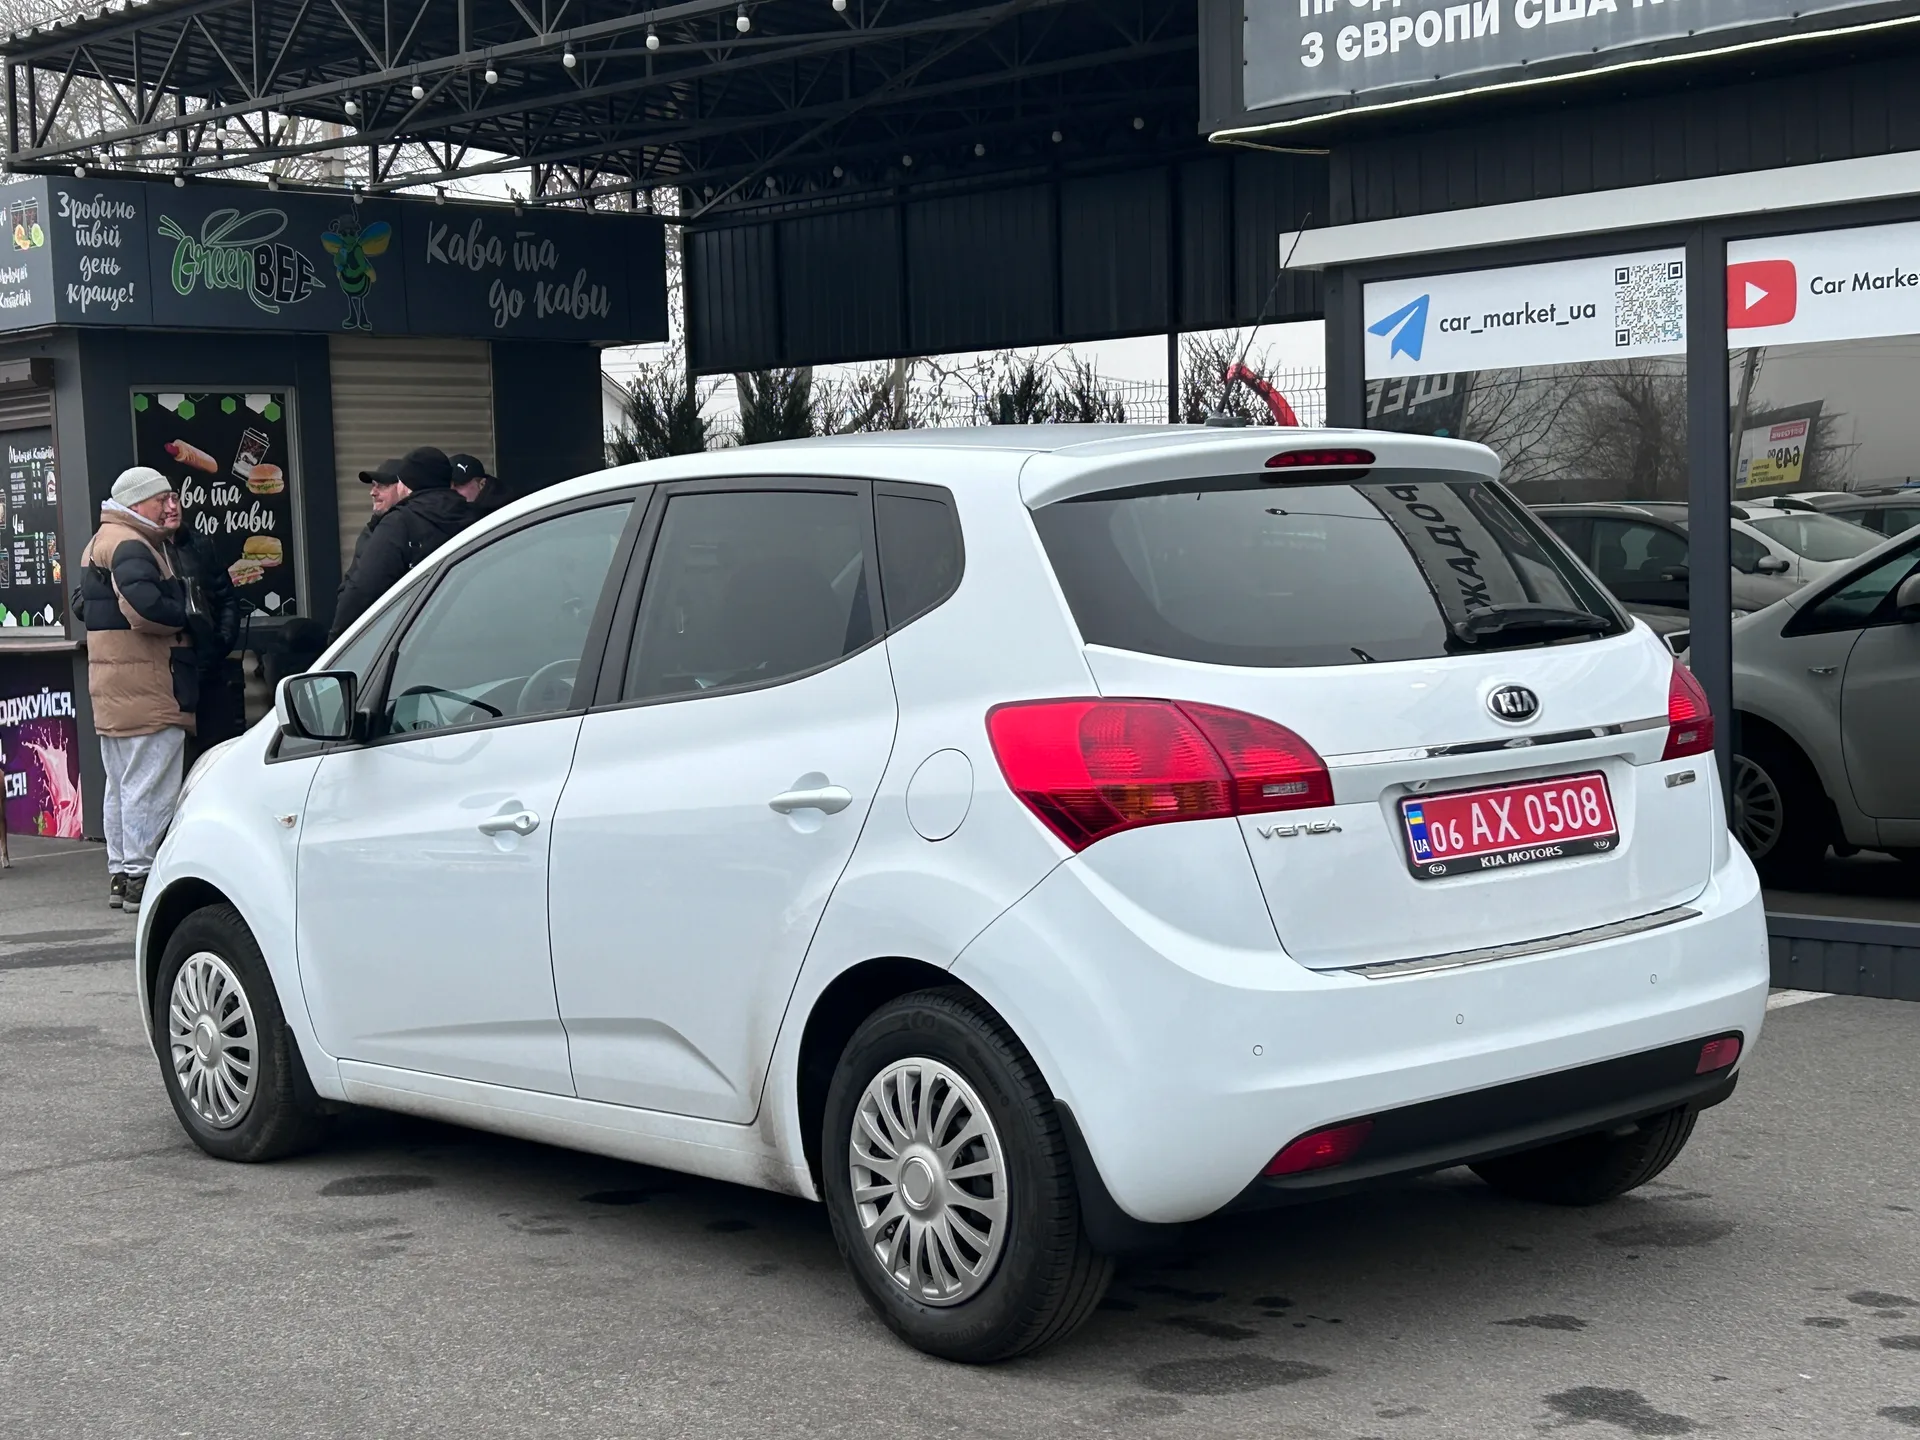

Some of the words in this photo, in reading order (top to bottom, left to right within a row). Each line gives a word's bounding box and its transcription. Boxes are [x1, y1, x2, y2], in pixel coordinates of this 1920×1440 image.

[1300, 31, 1325, 68] З
[1336, 0, 1500, 62] ЄВРОПИ
[75, 219, 122, 248] твій
[426, 218, 507, 272] Кава
[513, 231, 559, 272] та
[79, 255, 121, 282] день
[1810, 276, 1846, 295] Car
[1852, 267, 1920, 292] Marke
[66, 282, 135, 314] краще!
[488, 278, 525, 329] до
[533, 268, 611, 320] кави
[1439, 301, 1596, 334] car_market_ua
[180, 476, 207, 508] ва
[211, 481, 242, 506] та
[194, 511, 219, 535] до
[224, 500, 276, 533] кави
[1496, 690, 1536, 714] KIA
[1430, 818, 1465, 852] 06
[1471, 796, 1522, 845] AX
[1524, 786, 1601, 835] 0508
[1414, 839, 1430, 853] UA
[1480, 855, 1505, 867] KIA
[1508, 845, 1563, 863] MOTORS
